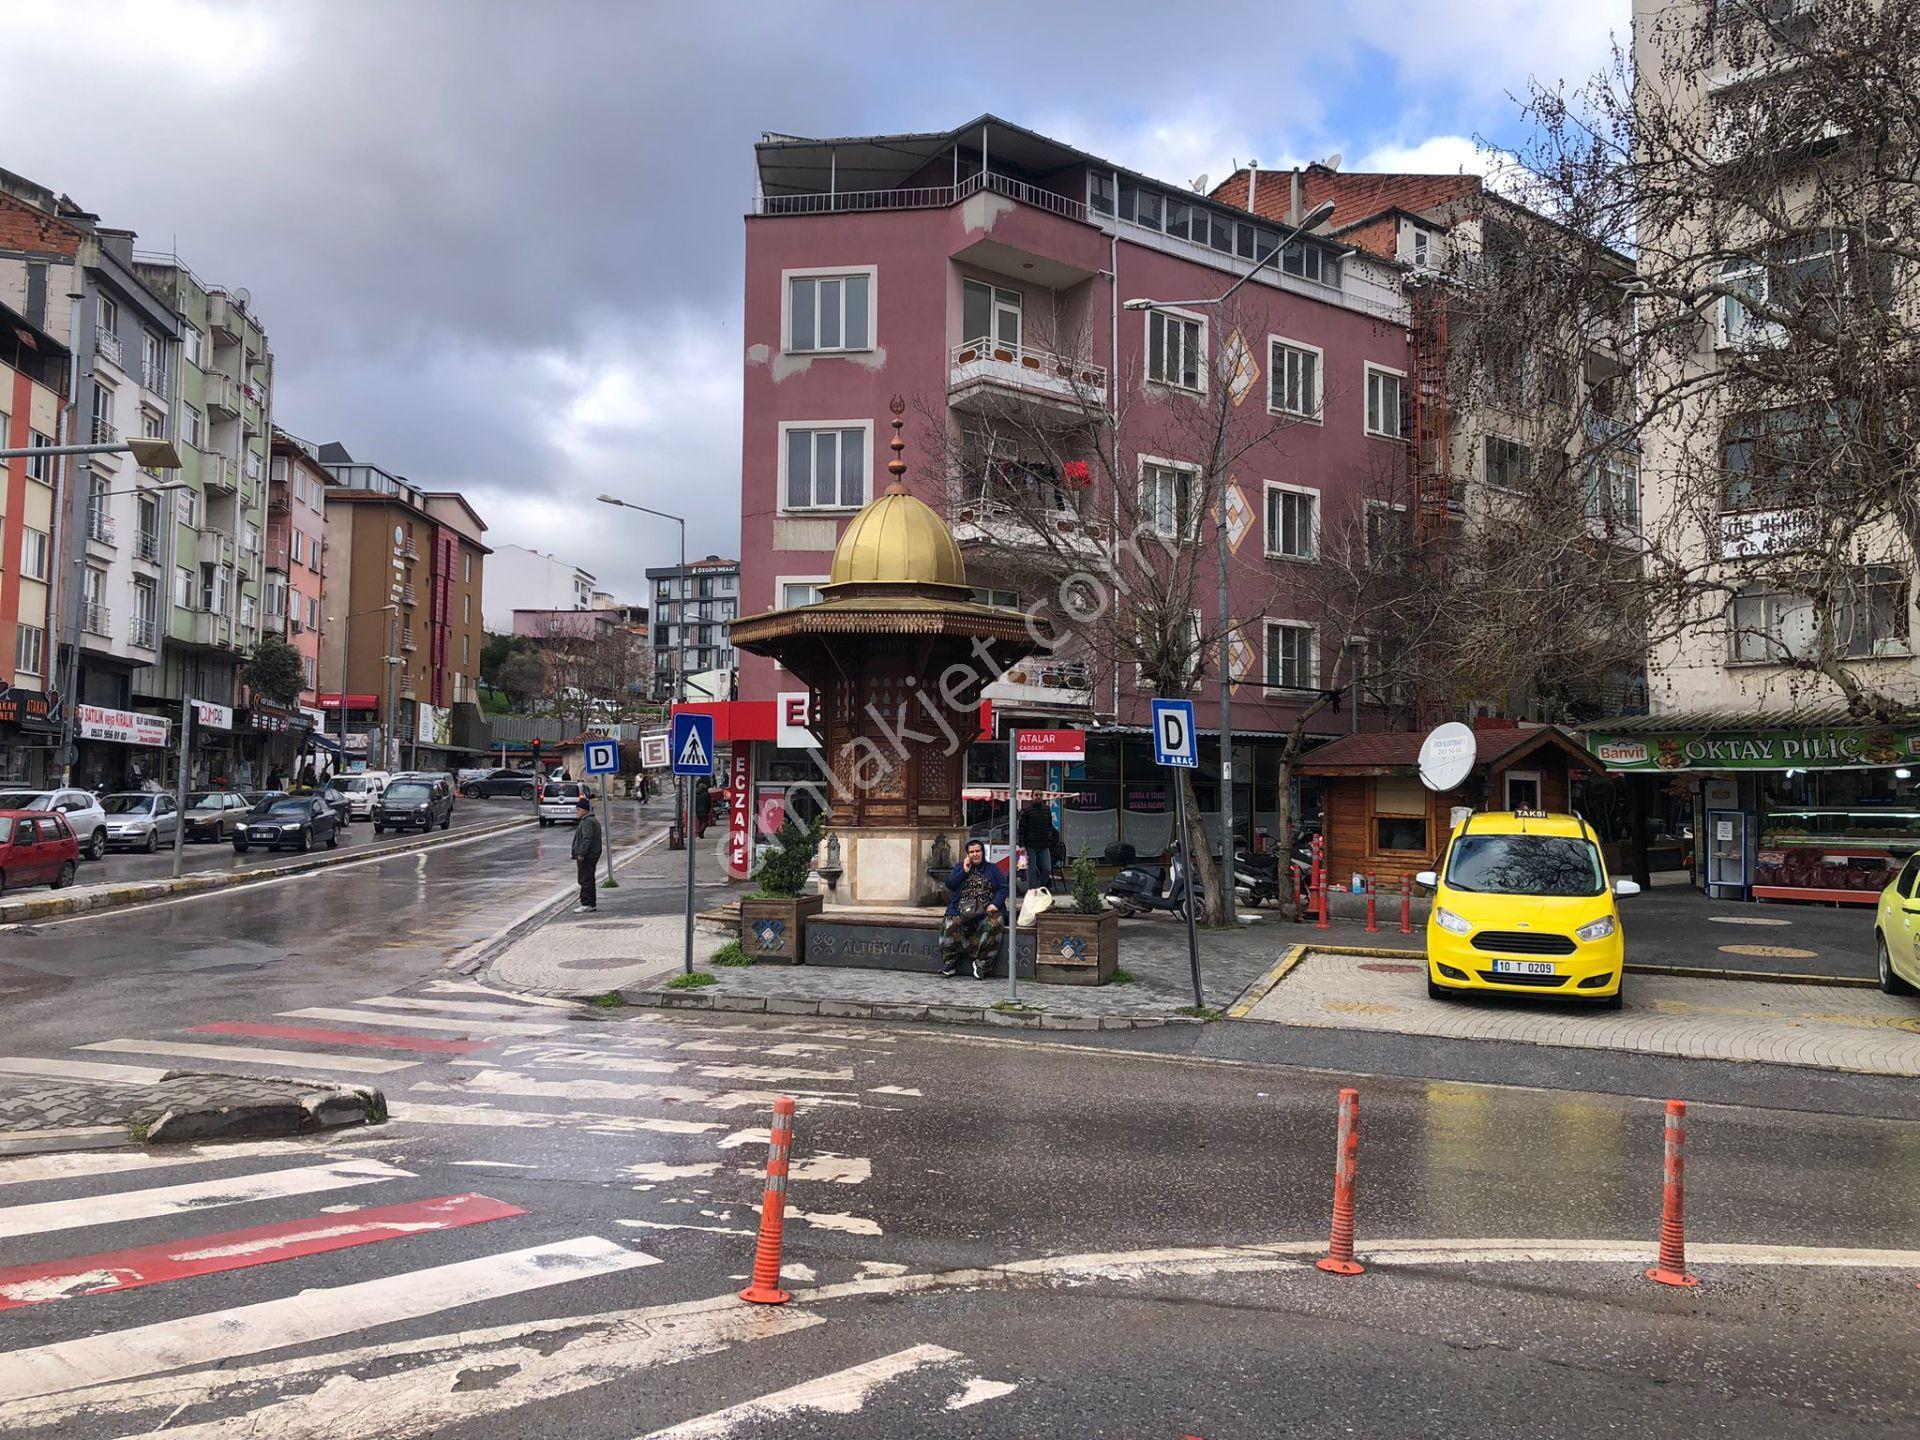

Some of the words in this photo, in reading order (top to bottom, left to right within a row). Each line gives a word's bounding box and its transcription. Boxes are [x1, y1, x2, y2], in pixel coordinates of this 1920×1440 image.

[84, 707, 104, 725] SATILIK
[115, 713, 134, 730] KIRALIK
[1019, 734, 1056, 743] ATALAR
[1163, 714, 1183, 750] D
[594, 748, 609, 766] D
[1601, 745, 1646, 761] Banvit
[1685, 739, 1773, 761] OKTAY
[1781, 733, 1860, 763] PİLİÇ
[1171, 756, 1193, 766] ARAÇ
[733, 757, 746, 864] ECZANE
[1500, 962, 1510, 972] 10
[1516, 963, 1523, 972] T
[1528, 963, 1551, 973] 0209
